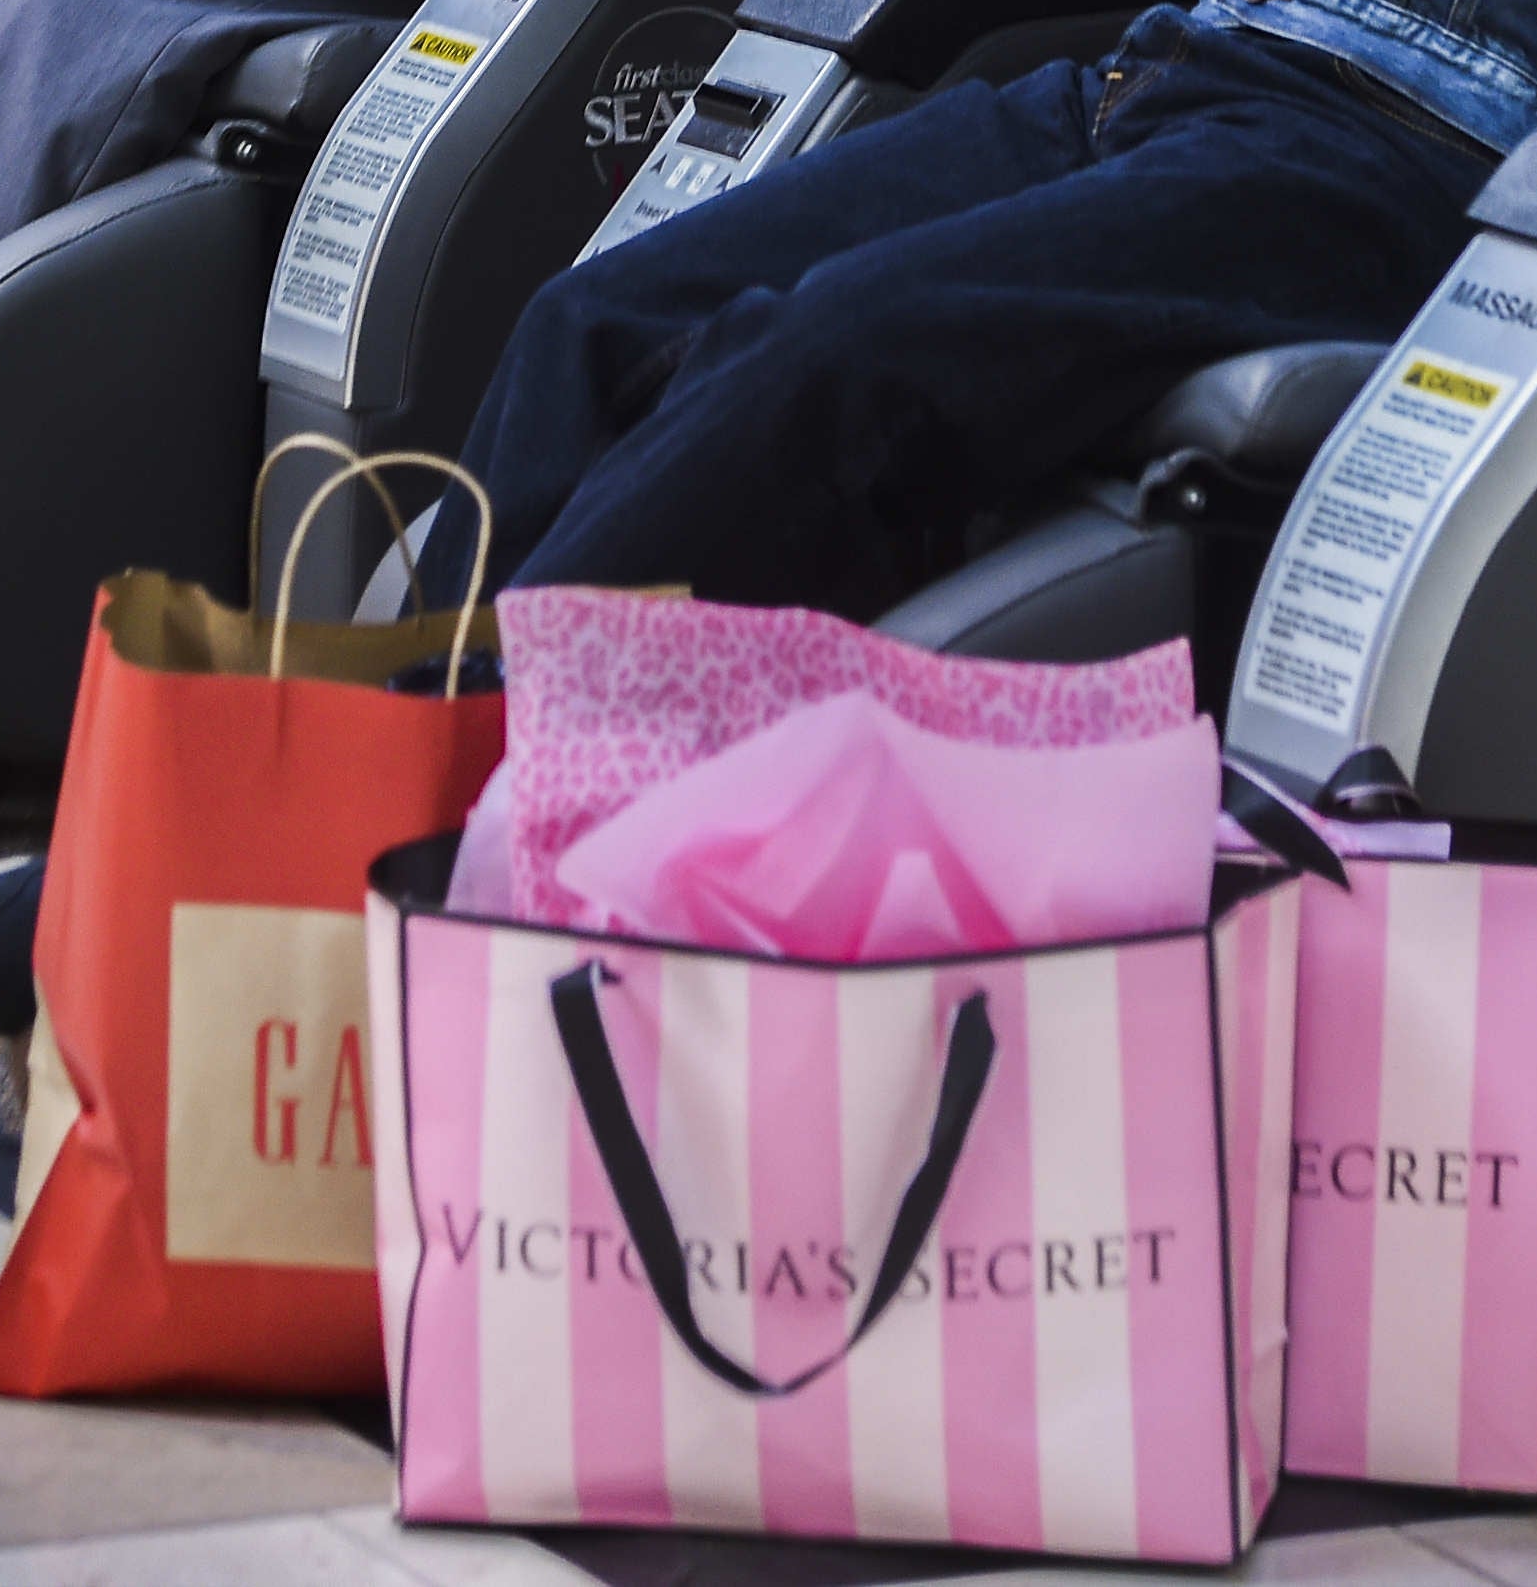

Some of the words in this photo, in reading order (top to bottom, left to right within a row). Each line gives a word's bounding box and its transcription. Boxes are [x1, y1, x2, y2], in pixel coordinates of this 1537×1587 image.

[426, 37, 474, 61] CAUTION
[1426, 370, 1495, 403] CAUTION
[253, 1016, 375, 1168] GA
[1290, 1141, 1519, 1208] ECRET
